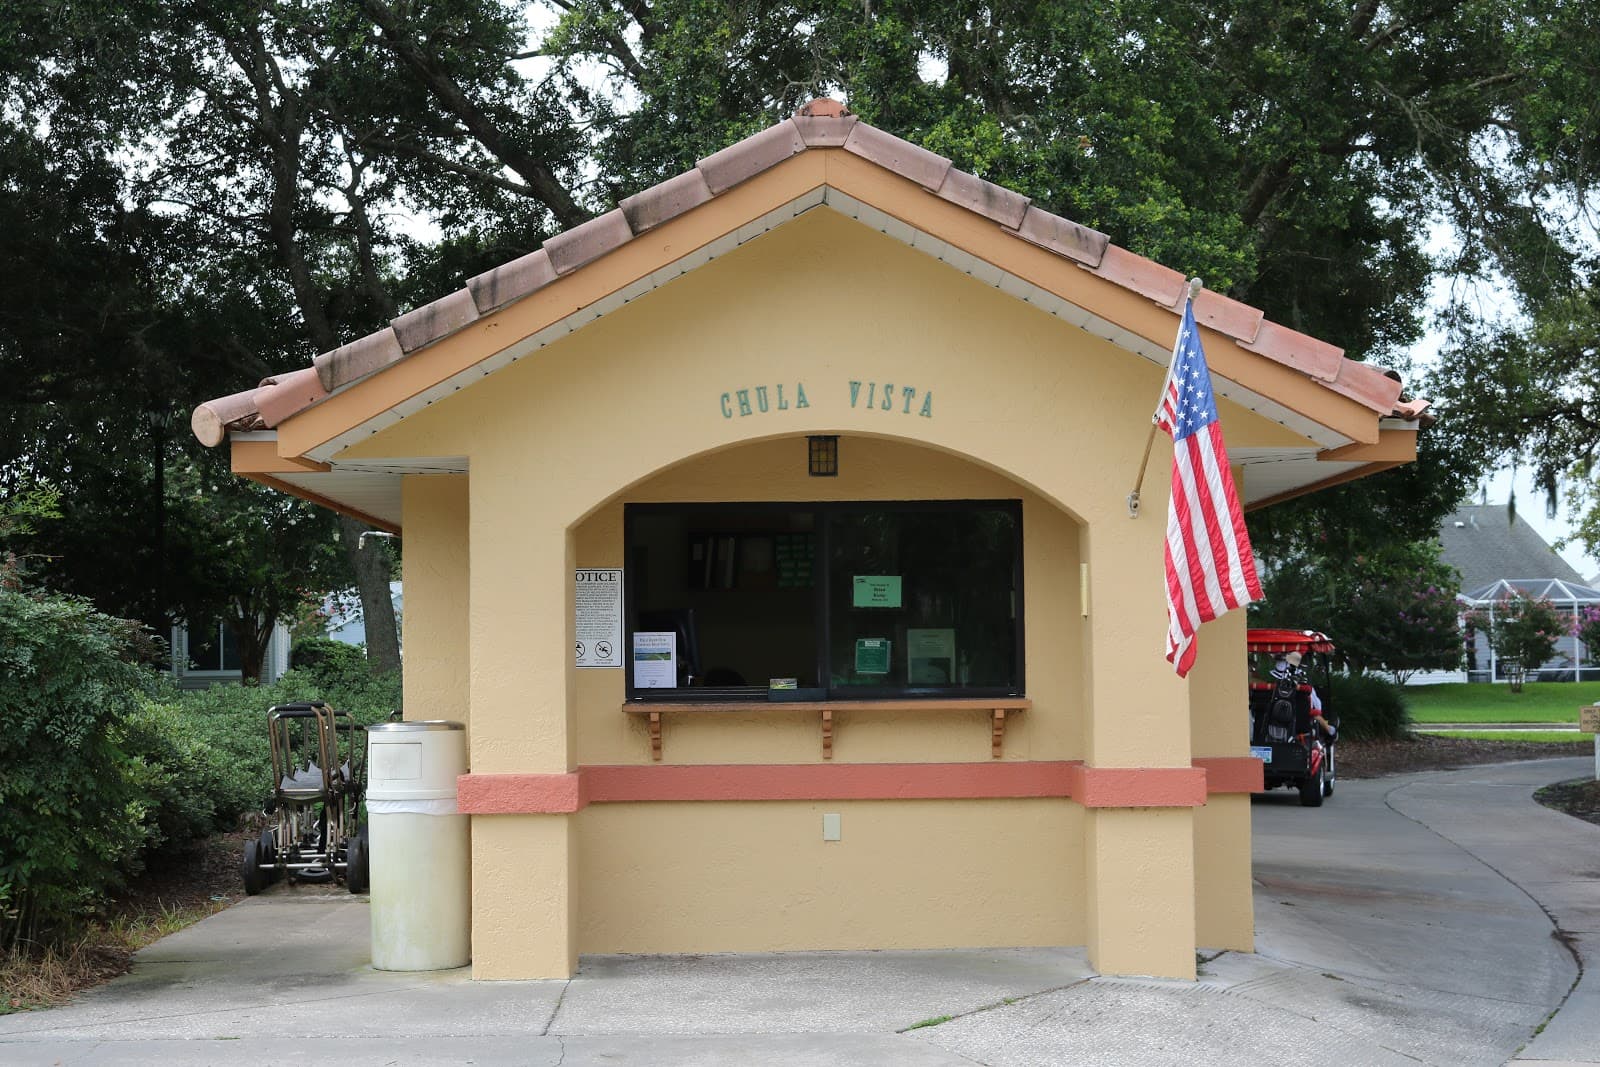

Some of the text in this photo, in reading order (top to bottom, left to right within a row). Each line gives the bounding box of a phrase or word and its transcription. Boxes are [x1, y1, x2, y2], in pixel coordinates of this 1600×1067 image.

[720, 381, 932, 419] CHULA VISTA
[576, 572, 617, 582] OTICE
